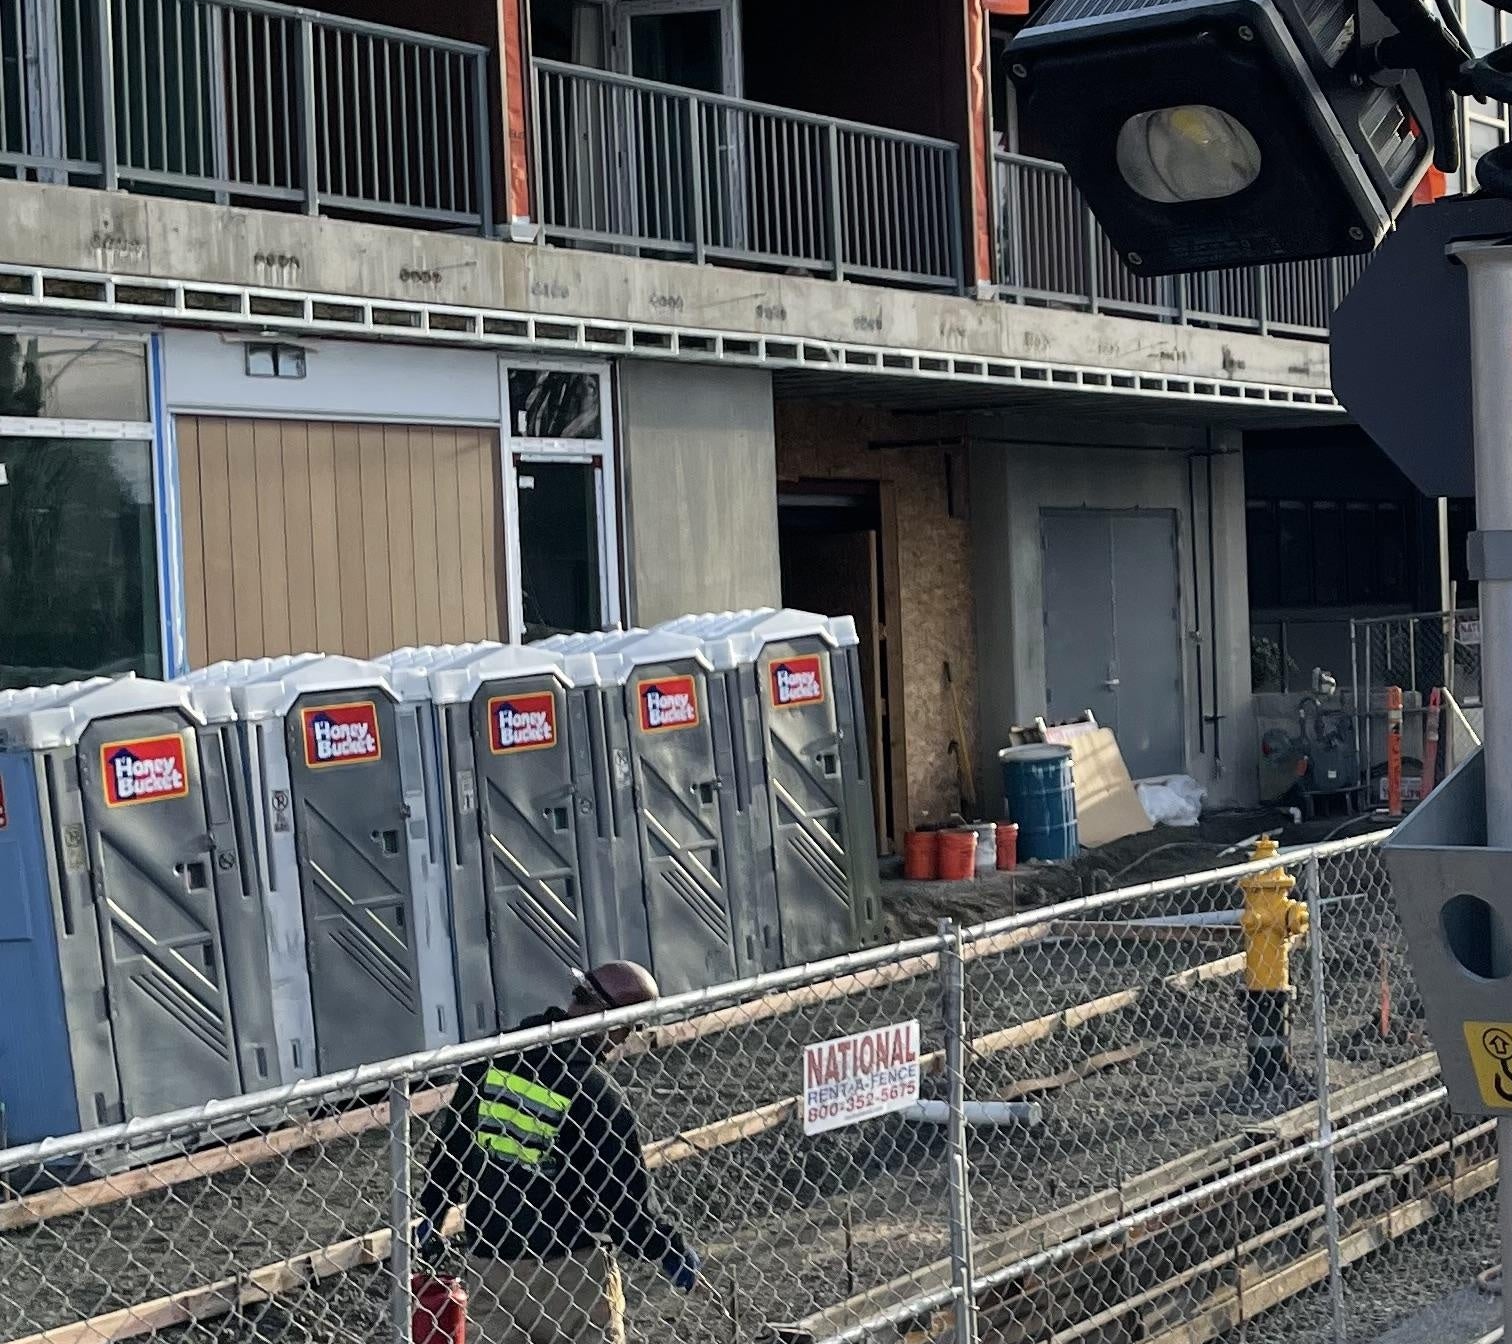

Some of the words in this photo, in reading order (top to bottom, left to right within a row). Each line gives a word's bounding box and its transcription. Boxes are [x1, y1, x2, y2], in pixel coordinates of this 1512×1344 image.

[314, 721, 369, 743] Honey
[499, 709, 547, 729] Honey
[318, 733, 377, 760] Bucket
[501, 721, 553, 747] Bucket
[114, 755, 176, 778] Honey
[118, 768, 184, 799] Bucket
[807, 1026, 916, 1088] NATIONAL
[807, 1064, 917, 1106] RENT-A-FENCE
[808, 1081, 916, 1124] 800-352-5675
